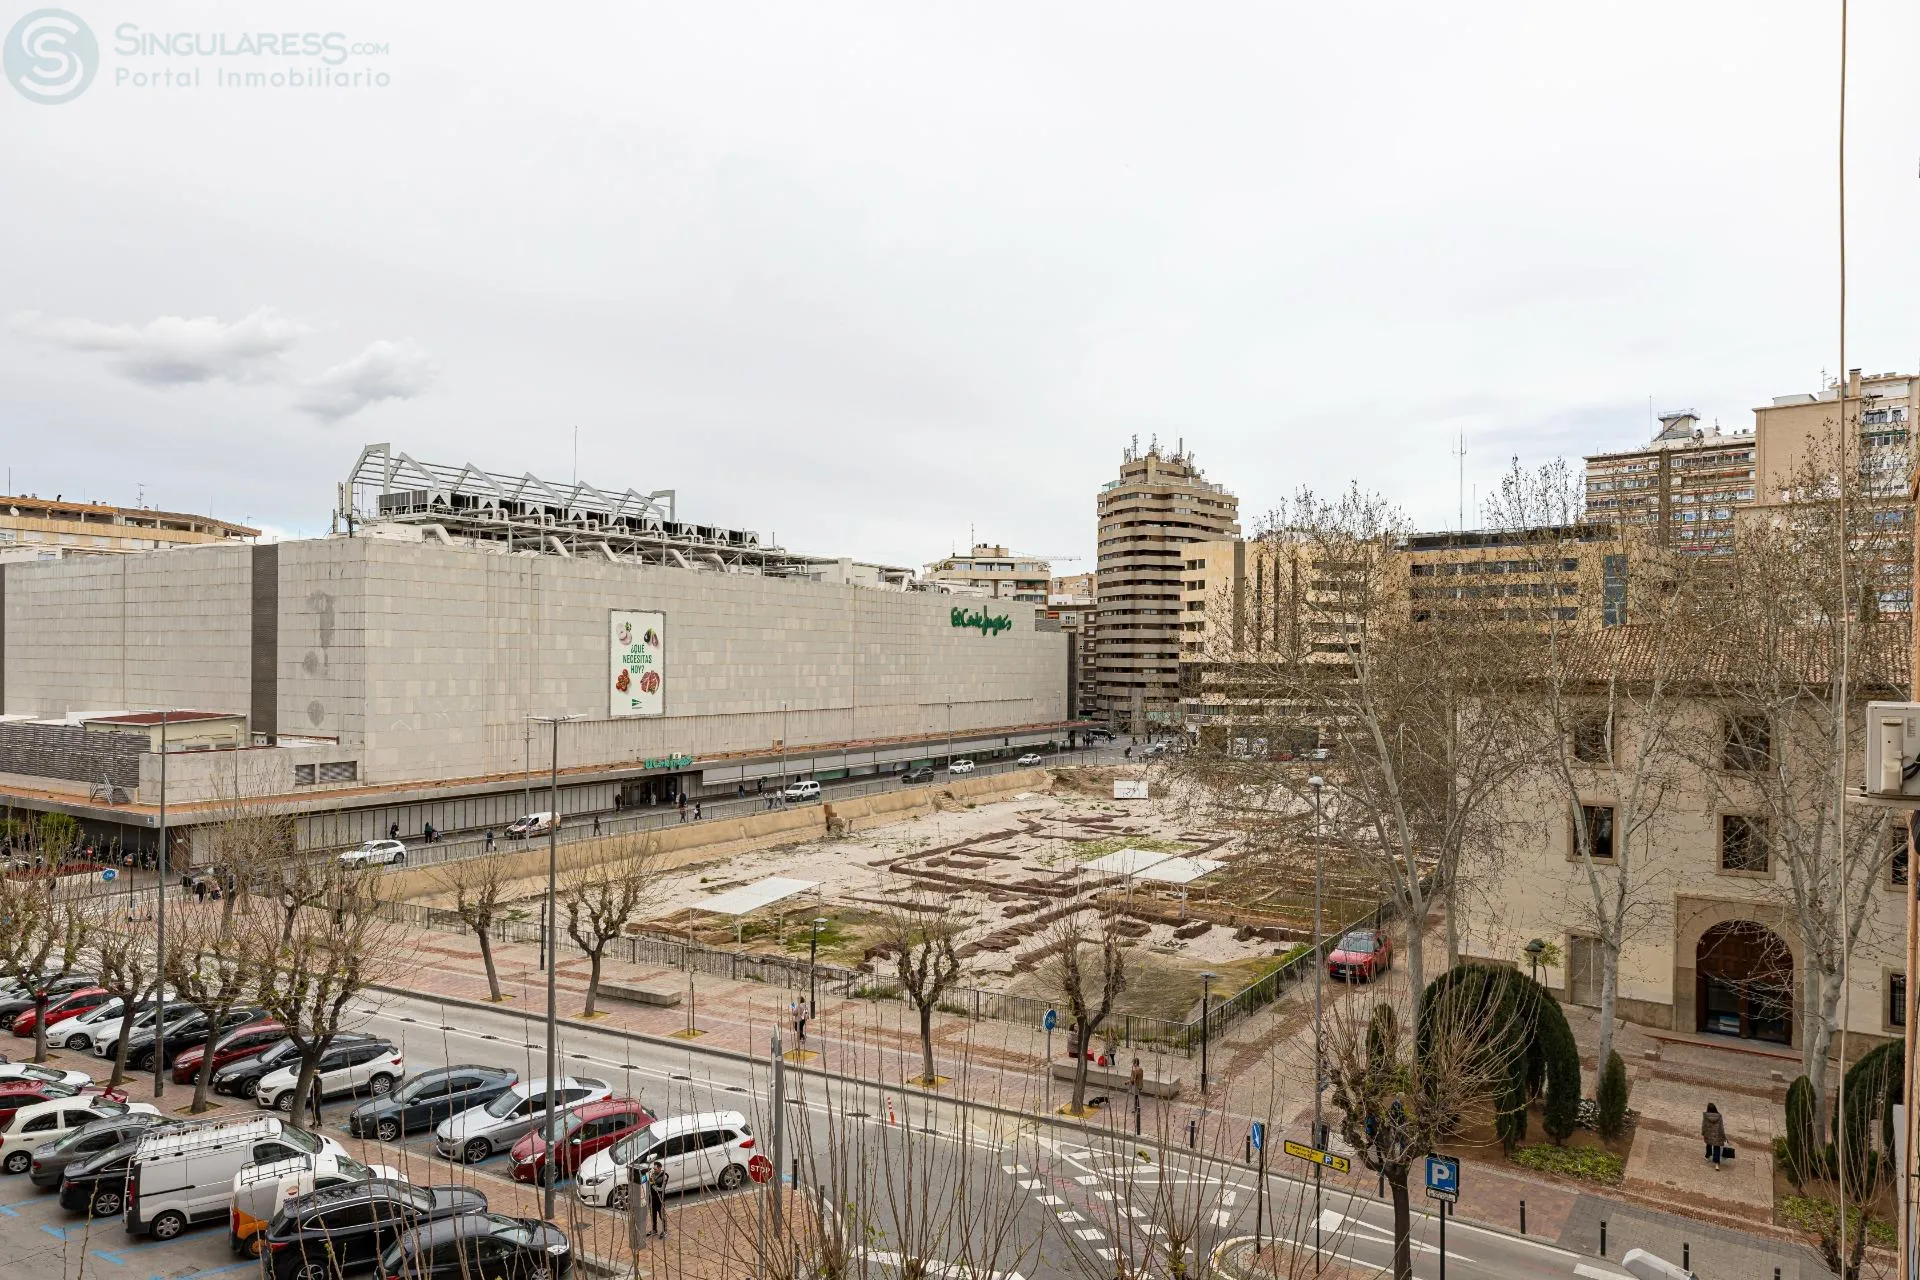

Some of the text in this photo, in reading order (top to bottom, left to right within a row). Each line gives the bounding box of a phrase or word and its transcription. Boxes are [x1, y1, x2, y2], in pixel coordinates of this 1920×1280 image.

[630, 643, 645, 654] ¿QUÉ
[622, 654, 653, 664] NECESITAS
[630, 665, 645, 674] HOY?
[750, 1164, 771, 1174] STOP
[1431, 1162, 1450, 1186] P
